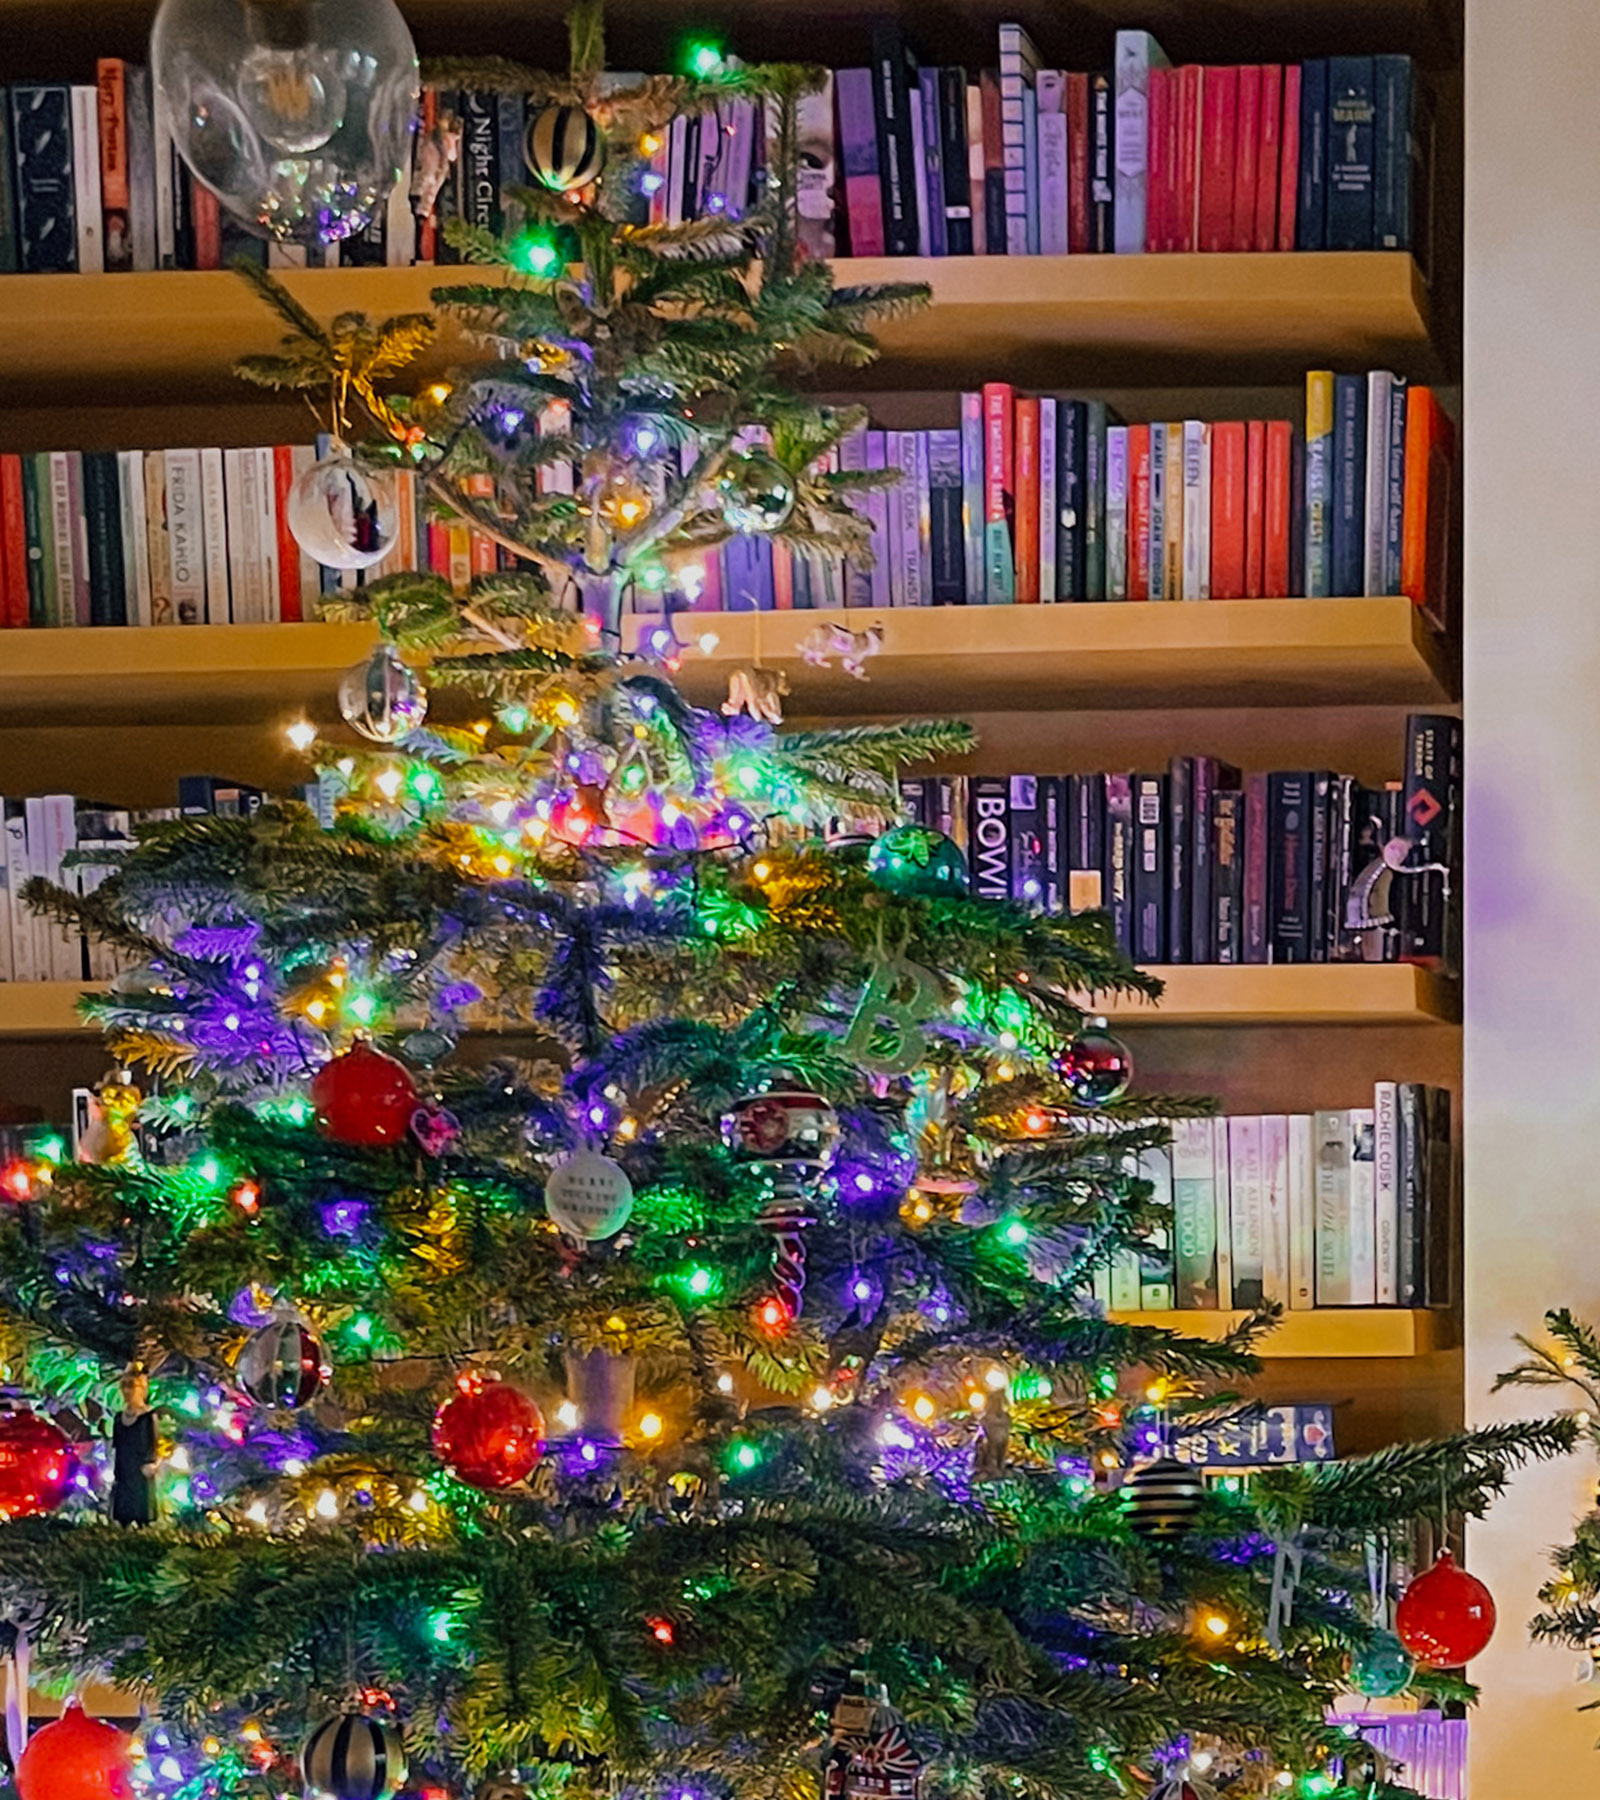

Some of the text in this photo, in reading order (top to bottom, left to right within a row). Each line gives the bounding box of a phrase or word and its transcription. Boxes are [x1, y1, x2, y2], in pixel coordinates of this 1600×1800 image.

[470, 117, 494, 177] Night
[1392, 391, 1405, 445] freedom
[1153, 429, 1163, 469] MIAMI
[171, 466, 191, 583] FRIDA KAHLO
[904, 492, 918, 531] CUSK
[1153, 506, 1163, 542] JOAN
[906, 549, 921, 606] TRANSIT
[1424, 728, 1434, 762] STATE
[976, 797, 1008, 897] BOWI
[1379, 1090, 1393, 1275] RACHEL CUSK COVENTRY
[1181, 1185, 1196, 1257] ATWOOD
